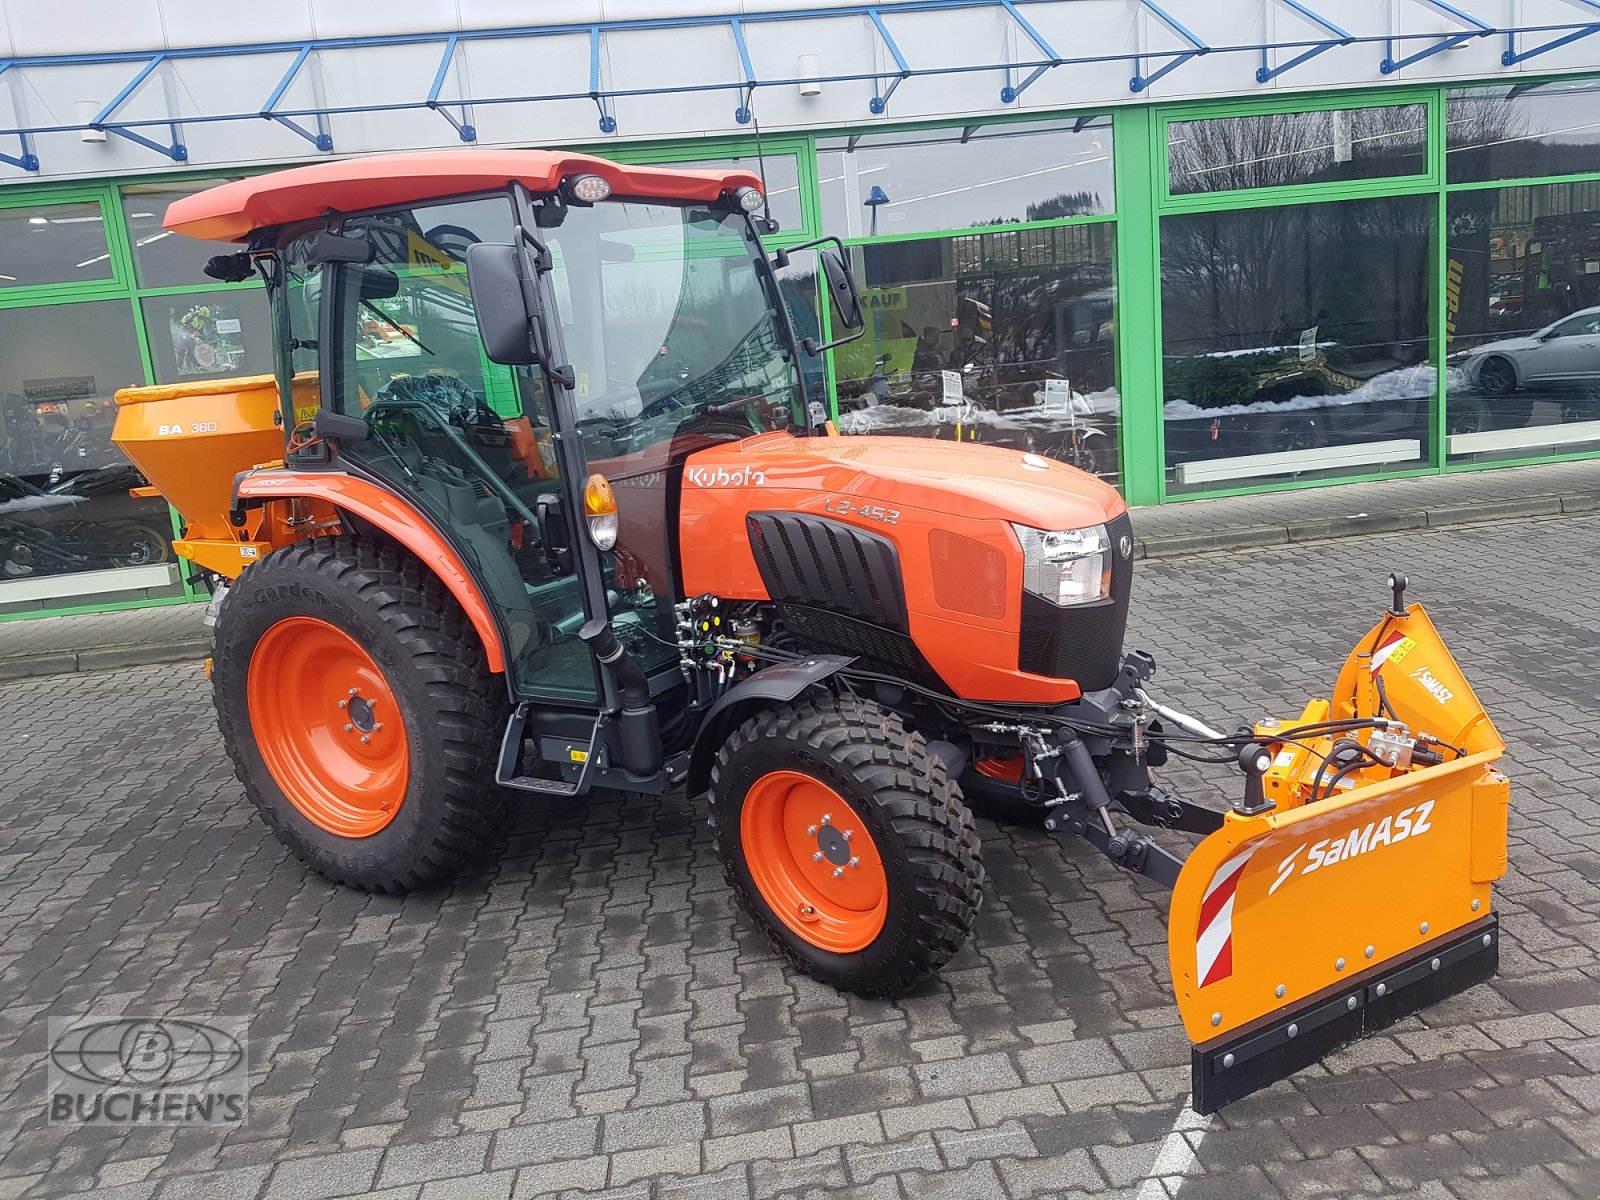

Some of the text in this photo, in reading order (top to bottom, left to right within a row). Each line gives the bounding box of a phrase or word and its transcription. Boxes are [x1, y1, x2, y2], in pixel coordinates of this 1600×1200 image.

[1459, 227, 1477, 236] BRP
[859, 292, 901, 308] KAUF
[158, 421, 217, 436] SA 360
[689, 466, 765, 488] Kubota
[824, 498, 900, 525] L2-452
[1417, 670, 1454, 705] SaMASZ
[1301, 799, 1436, 875] SaMASZ
